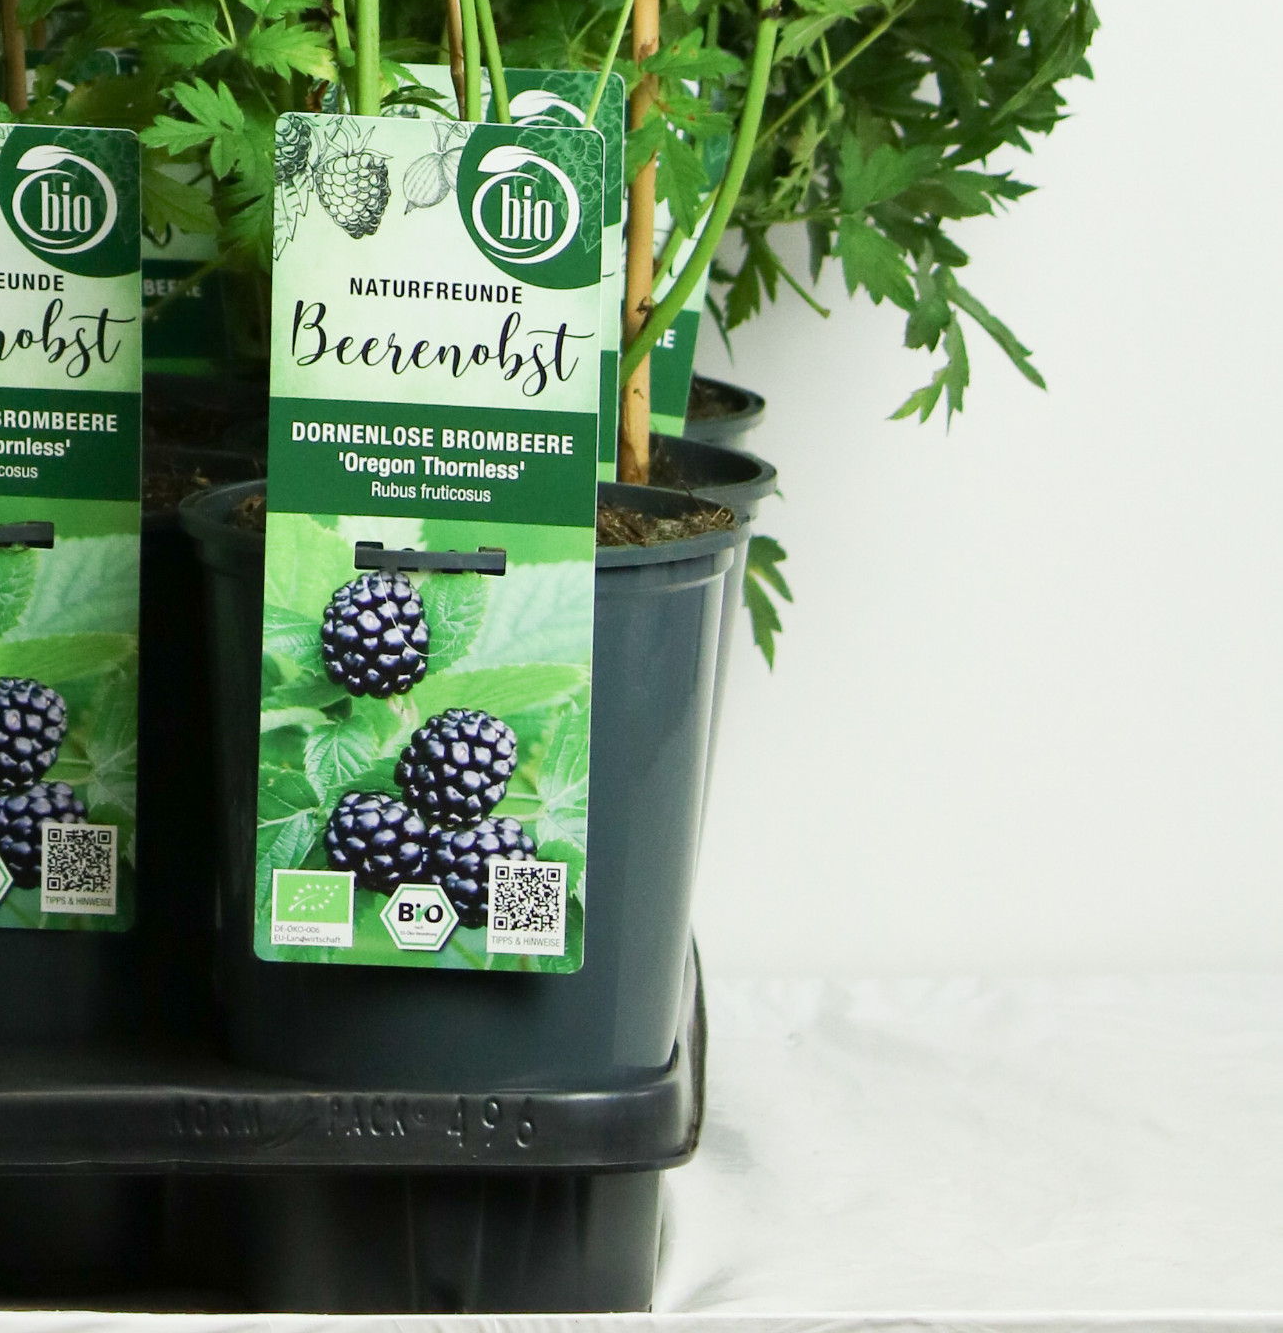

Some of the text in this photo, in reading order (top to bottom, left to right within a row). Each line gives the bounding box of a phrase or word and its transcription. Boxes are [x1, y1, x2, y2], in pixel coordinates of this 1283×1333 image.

[40, 181, 91, 232] bio
[499, 184, 552, 242] bio
[349, 277, 523, 304] NATURFREUNDE
[291, 300, 595, 397] Beerenobst
[292, 422, 573, 454] DORNENLOSE BROMBEERE
[339, 452, 524, 479] 'Oregon Thornless'
[372, 482, 491, 502] Rubus fruticosus
[46, 896, 113, 907] TIPPS & HINWEISE
[274, 934, 341, 943] EU-Landwirtschaft
[492, 936, 560, 947] TIPPS & HINWEISE
